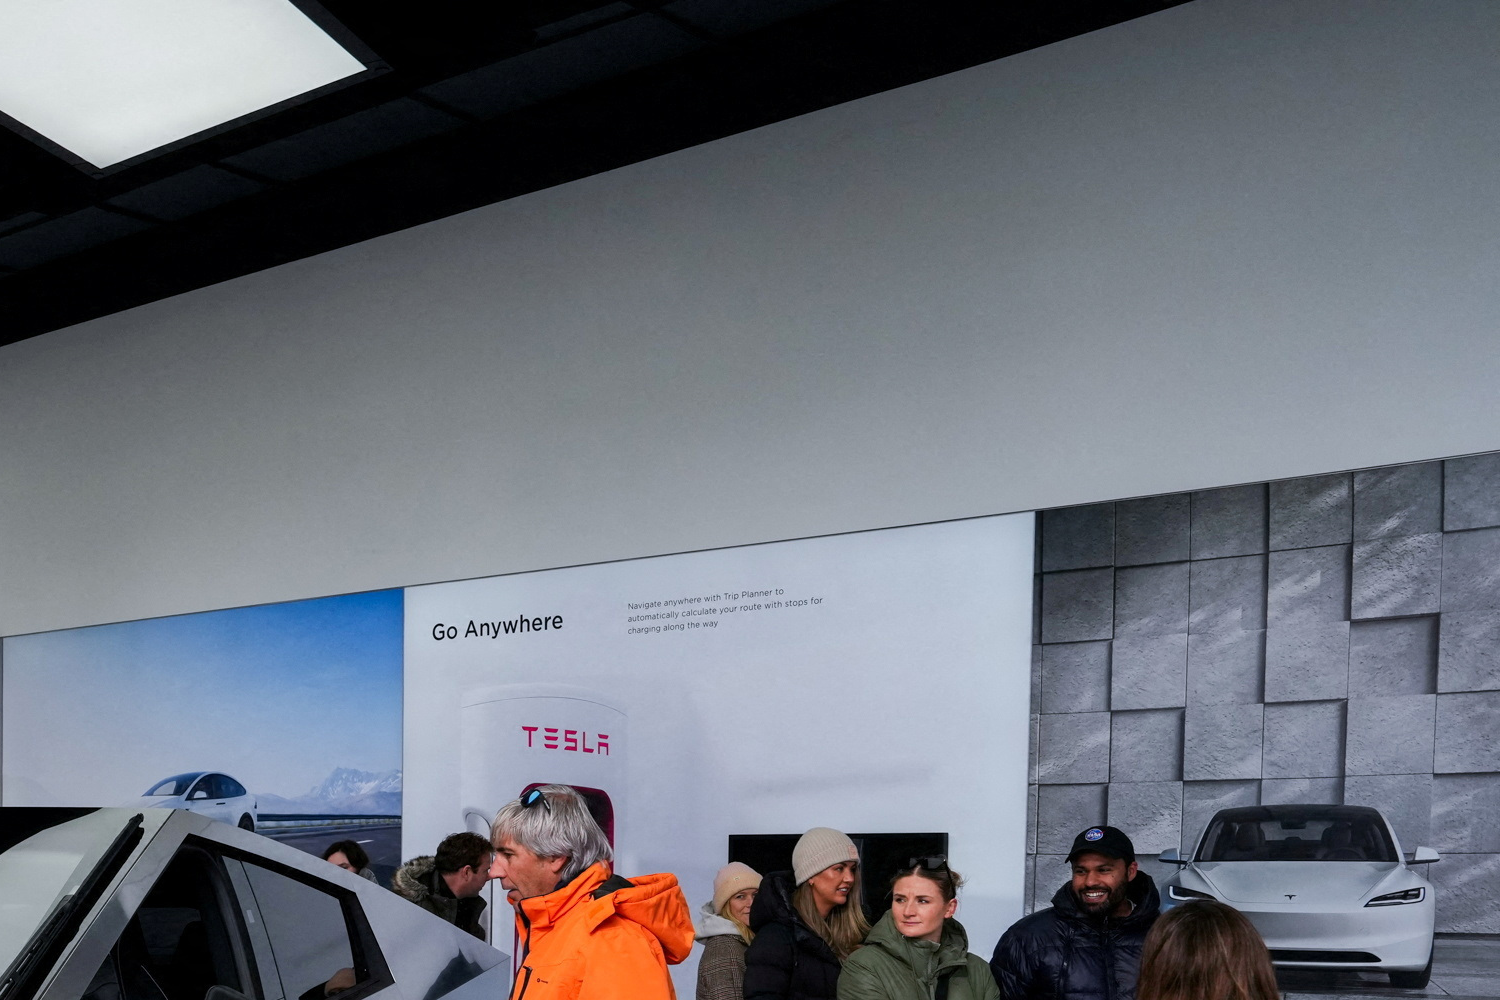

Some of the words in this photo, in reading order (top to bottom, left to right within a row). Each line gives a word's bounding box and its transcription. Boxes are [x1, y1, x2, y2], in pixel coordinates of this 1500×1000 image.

[628, 600, 662, 611] Navigate
[664, 597, 701, 607] anywhere
[704, 594, 721, 602] with
[724, 592, 739, 601] Trip
[742, 589, 773, 599] Planner
[628, 610, 679, 622] automatically
[682, 607, 717, 618] calculate
[719, 605, 737, 615] your
[740, 603, 762, 611] route
[764, 600, 782, 609] with
[785, 599, 808, 608] stops
[811, 597, 823, 605] for
[432, 623, 458, 641] Go
[464, 614, 564, 640] Anywhere
[628, 624, 661, 635] charging
[663, 622, 685, 632] along
[687, 621, 700, 629] the
[702, 620, 718, 629] way
[521, 725, 610, 756] TESLA
